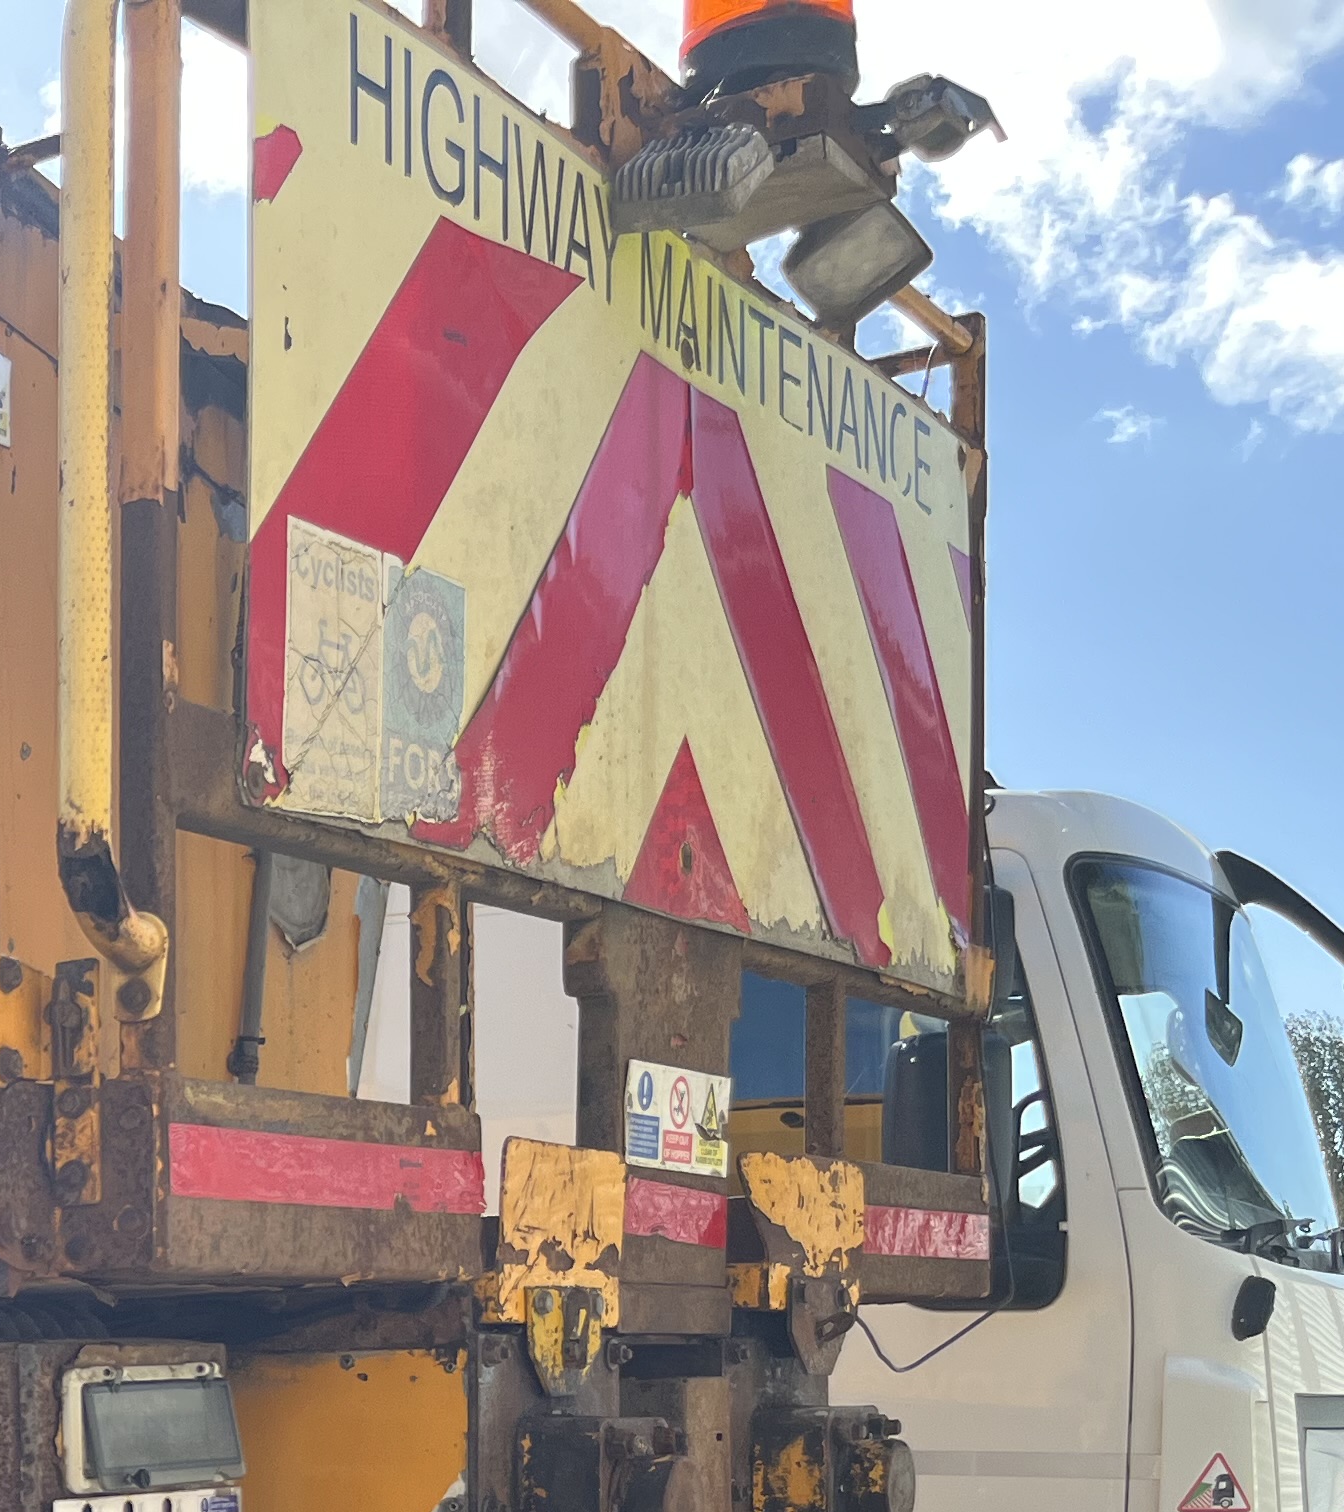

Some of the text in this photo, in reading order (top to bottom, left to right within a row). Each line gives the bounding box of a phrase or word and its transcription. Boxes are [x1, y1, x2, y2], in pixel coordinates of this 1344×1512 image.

[348, 12, 933, 516] HIGHWAY MAINTENANCE
[295, 541, 376, 602] Cyclists
